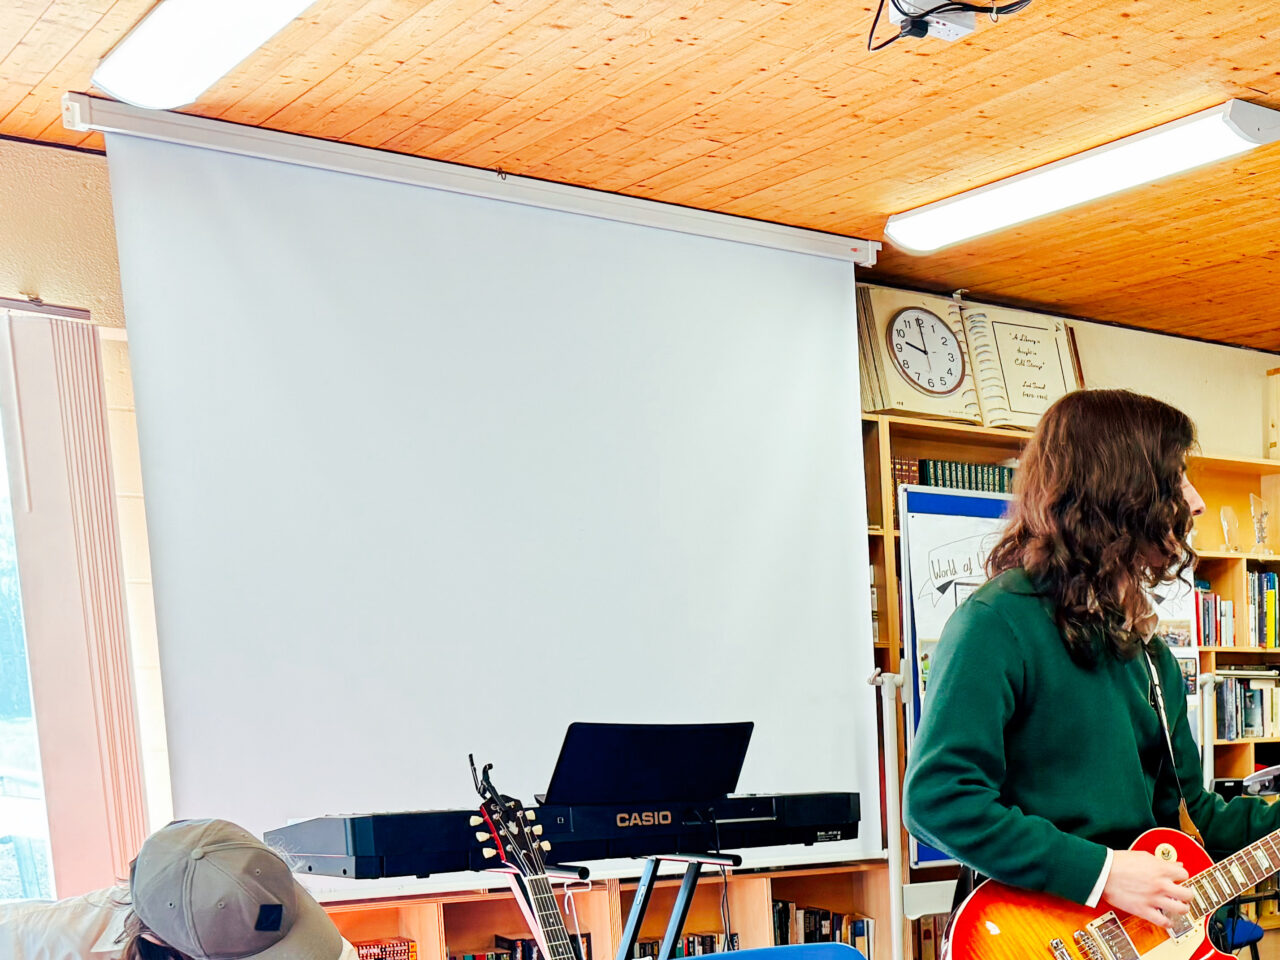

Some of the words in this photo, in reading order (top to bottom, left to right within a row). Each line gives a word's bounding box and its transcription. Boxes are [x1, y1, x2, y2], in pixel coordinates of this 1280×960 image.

[904, 319, 911, 329] 11
[896, 328, 905, 338] 10
[941, 336, 948, 346] 2
[895, 343, 903, 352] 9
[948, 352, 955, 362] 3
[903, 360, 910, 369] 8
[915, 372, 921, 381] 7
[947, 368, 953, 376] 4
[928, 378, 935, 388] 6
[940, 376, 947, 386] 5
[931, 558, 957, 580] World
[963, 556, 973, 575] of
[616, 810, 672, 828] CASIO
